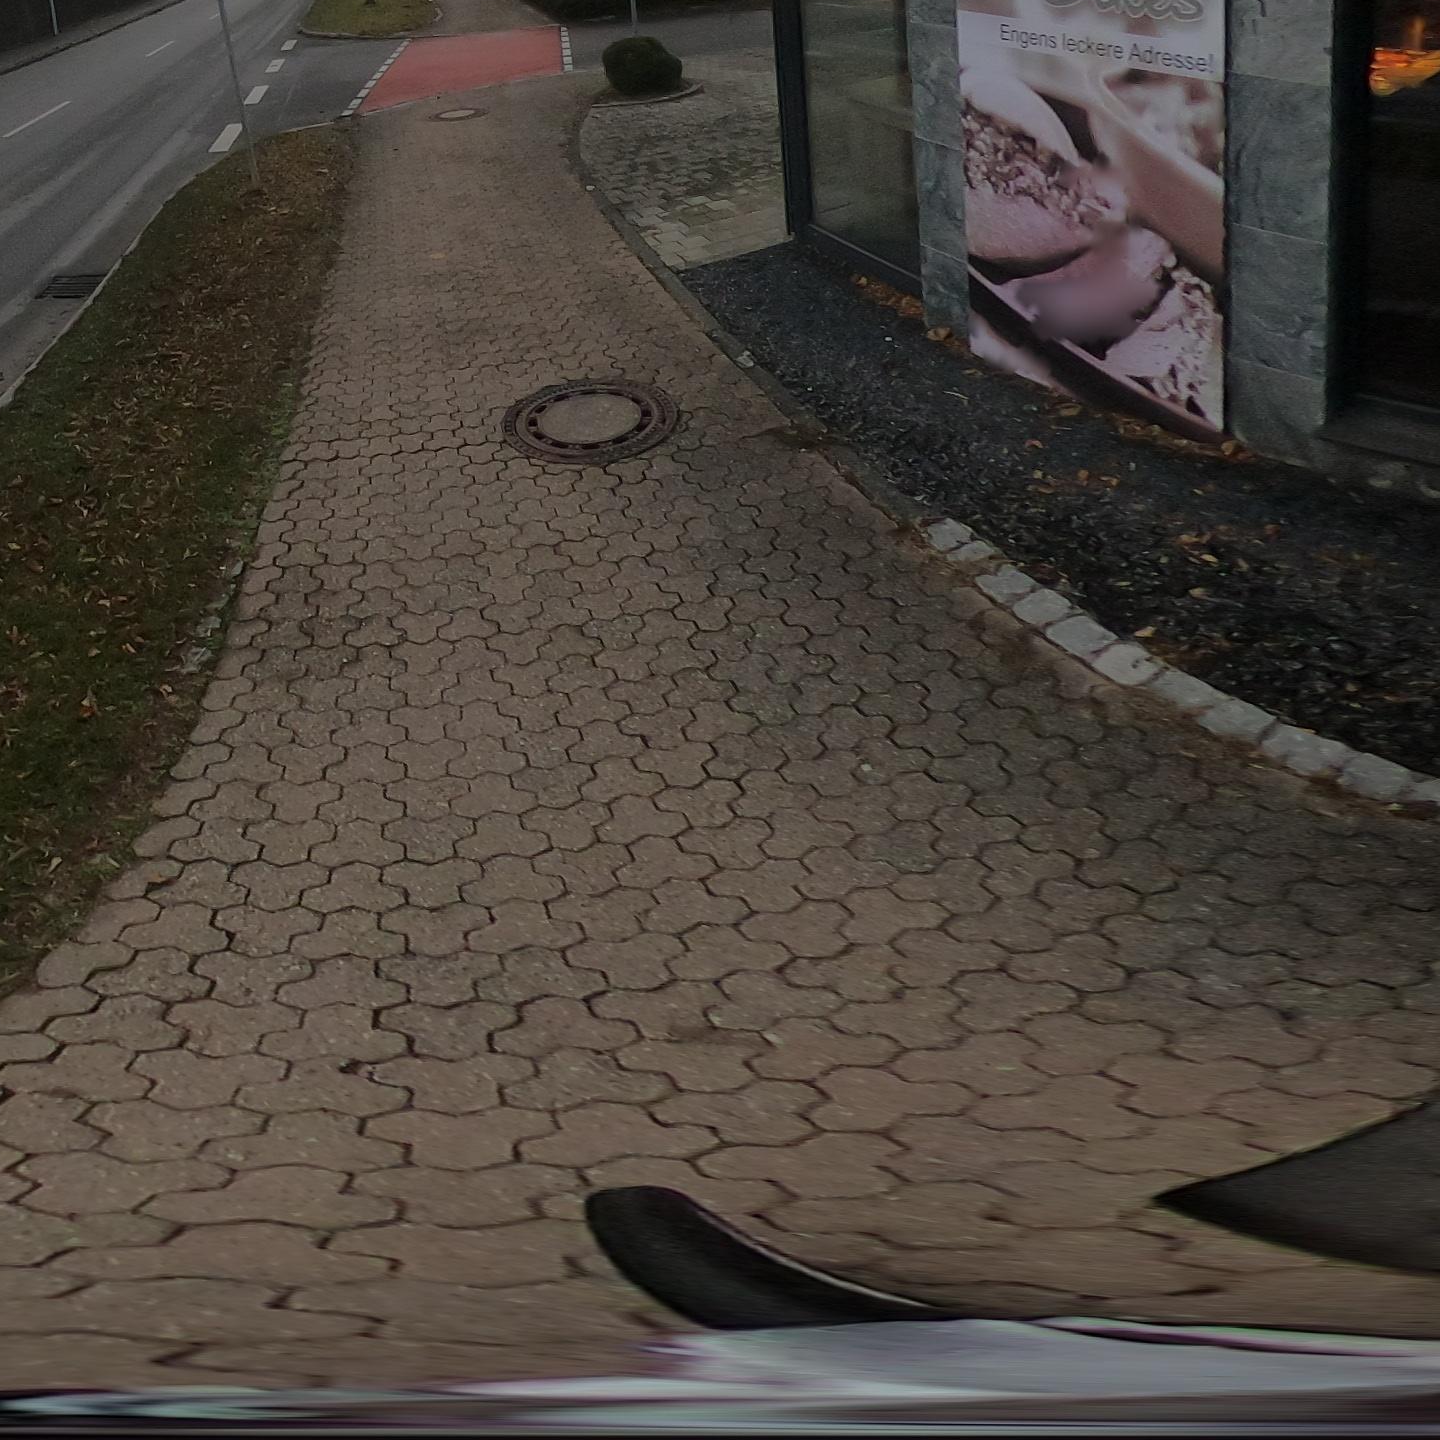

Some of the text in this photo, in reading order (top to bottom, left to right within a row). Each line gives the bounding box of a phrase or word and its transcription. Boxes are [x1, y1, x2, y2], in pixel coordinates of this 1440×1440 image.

[1000, 23, 1215, 73] Engens leckere Adresse!
